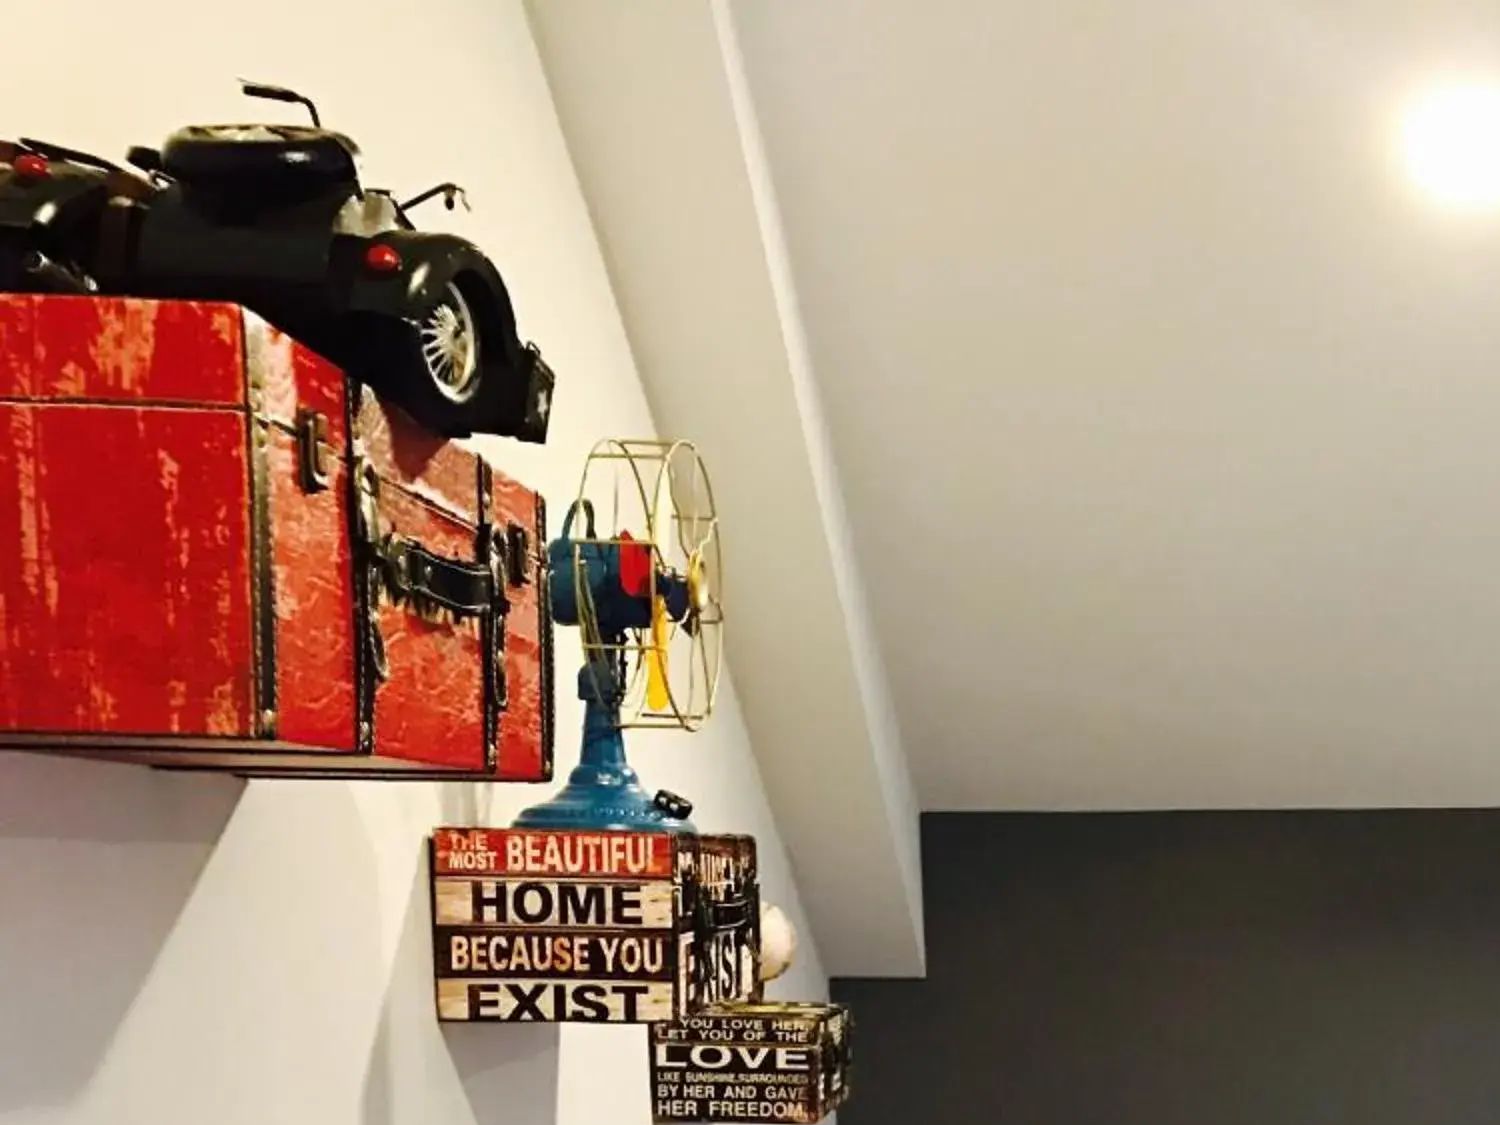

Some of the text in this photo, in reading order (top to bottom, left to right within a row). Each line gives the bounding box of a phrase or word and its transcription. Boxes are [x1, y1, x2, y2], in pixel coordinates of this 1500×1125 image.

[448, 832, 663, 873] THE BEAUTIFUL
[448, 851, 498, 870] MOST
[471, 880, 643, 925] HOME
[451, 935, 664, 973] BECAUSE YOU
[467, 983, 649, 1021] EXIST
[679, 1018, 713, 1030] YOU
[722, 1019, 763, 1030] LOVE
[657, 1029, 808, 1043] LET YOU OF THE
[656, 1044, 809, 1070] LOVE
[657, 1071, 681, 1083] LIKE
[657, 1085, 809, 1100] BY HER AND GAVE
[657, 1101, 698, 1116] HER
